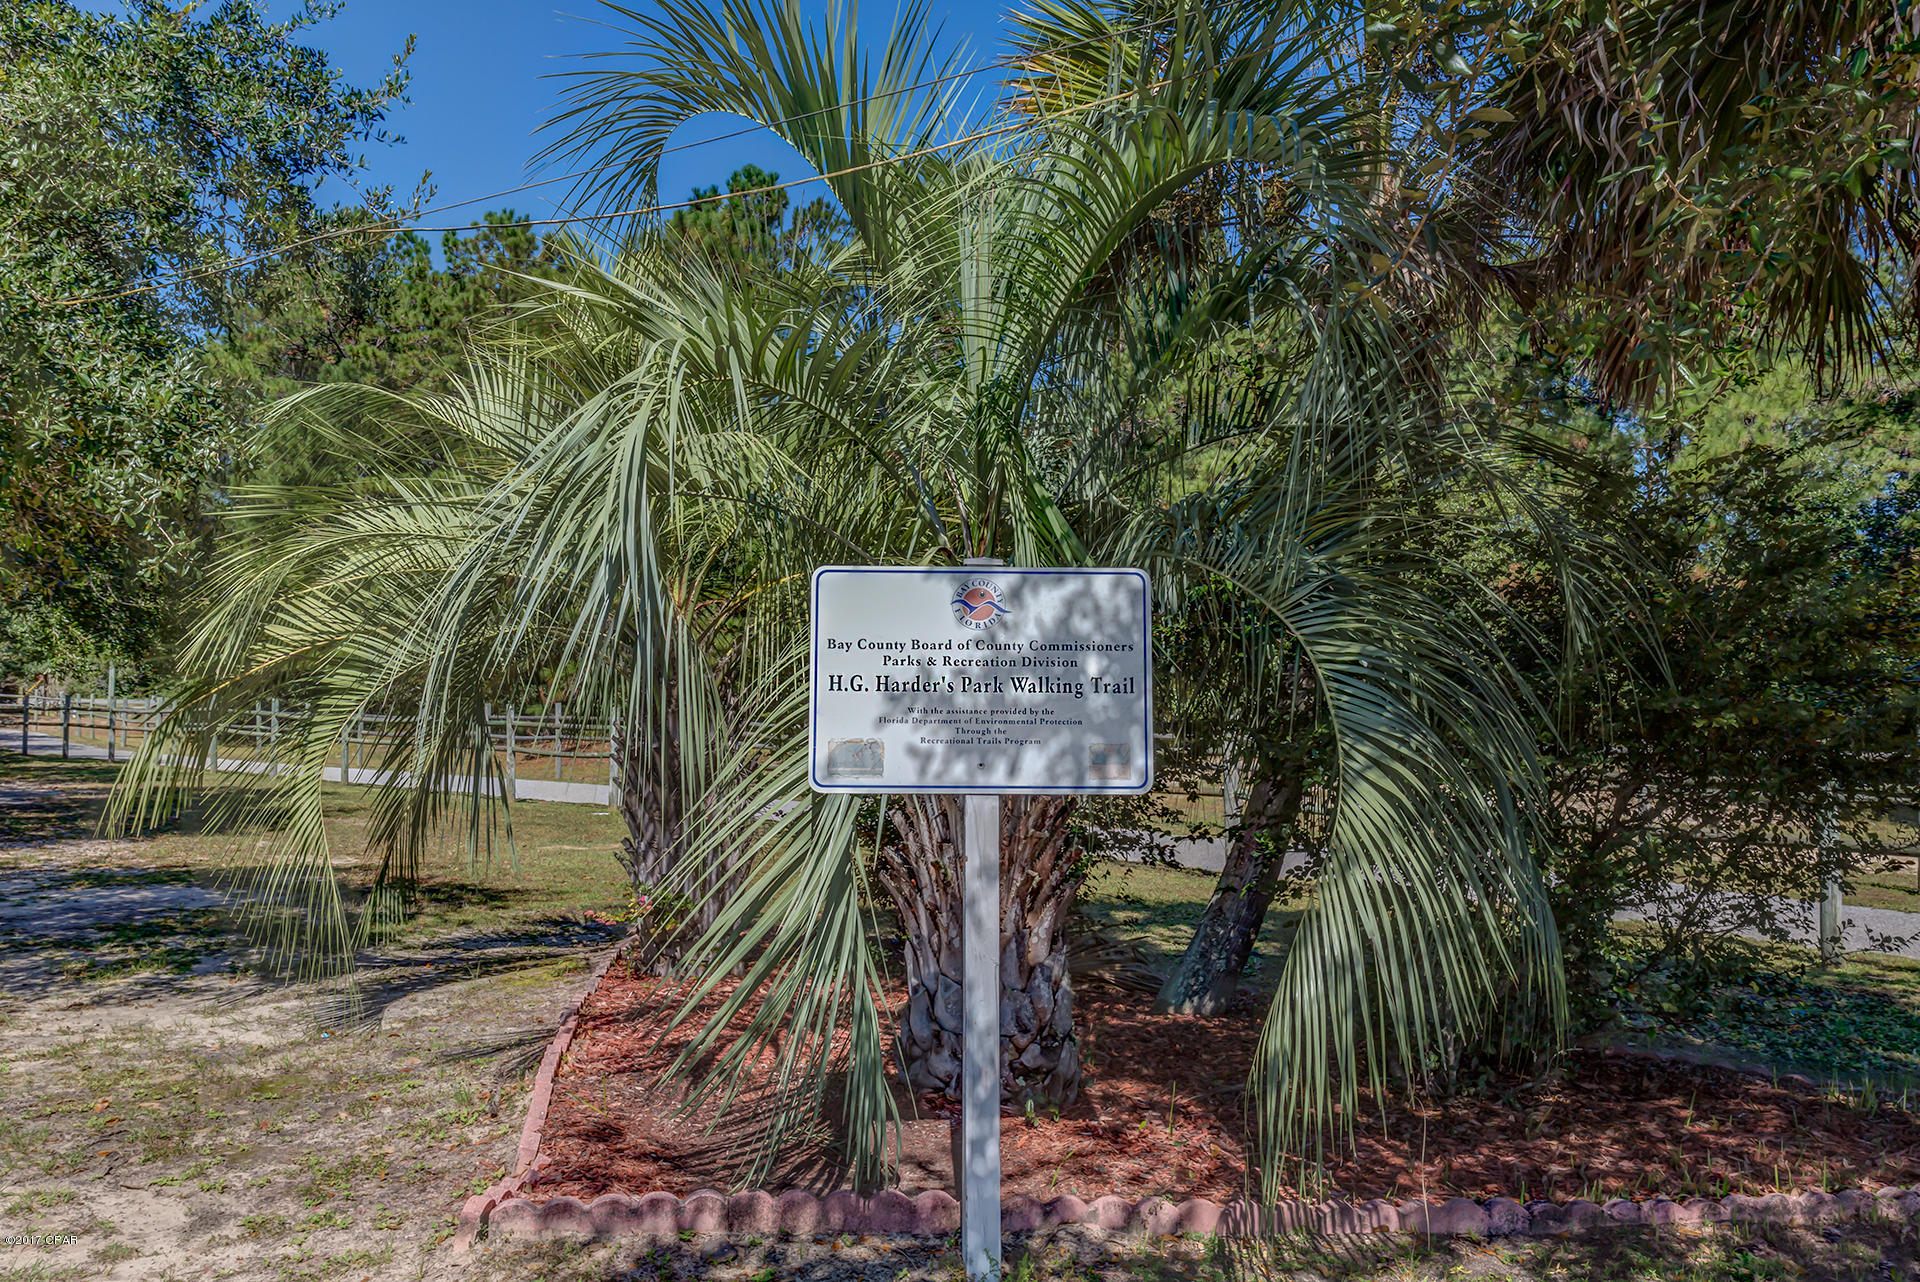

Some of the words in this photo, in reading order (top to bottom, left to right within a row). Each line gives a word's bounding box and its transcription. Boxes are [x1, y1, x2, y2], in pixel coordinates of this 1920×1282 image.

[956, 582, 970, 598] BAY
[972, 580, 1004, 603] COUNTY
[954, 608, 1002, 629] FLORIDA
[827, 638, 852, 652] Bay
[857, 638, 906, 653] County
[911, 639, 952, 650] Board
[957, 639, 972, 650] of
[975, 640, 1024, 654] County
[1029, 640, 1134, 652] Commissioners
[883, 655, 921, 666] Parks
[926, 656, 937, 666] &
[942, 656, 1016, 667] Recreation
[1021, 656, 1078, 668] Division
[828, 674, 869, 692] H.G.
[875, 675, 954, 693] Harder's
[961, 676, 1004, 694] Park
[1010, 676, 1084, 699] Walking
[1090, 676, 1135, 694] Trail
[907, 706, 928, 715] With
[930, 707, 944, 715] the
[946, 707, 988, 715] assistance
[990, 708, 1027, 717] provided
[1029, 708, 1040, 717] by
[878, 716, 909, 724] Florida
[911, 717, 961, 726] Department
[964, 716, 974, 724] of
[975, 717, 1037, 725] Environmental
[1039, 717, 1083, 726] Protection
[955, 727, 991, 736] Through
[994, 727, 1007, 735] the
[920, 737, 974, 745] Recreational
[977, 737, 1002, 745] Trails
[1004, 737, 1041, 746] Program
